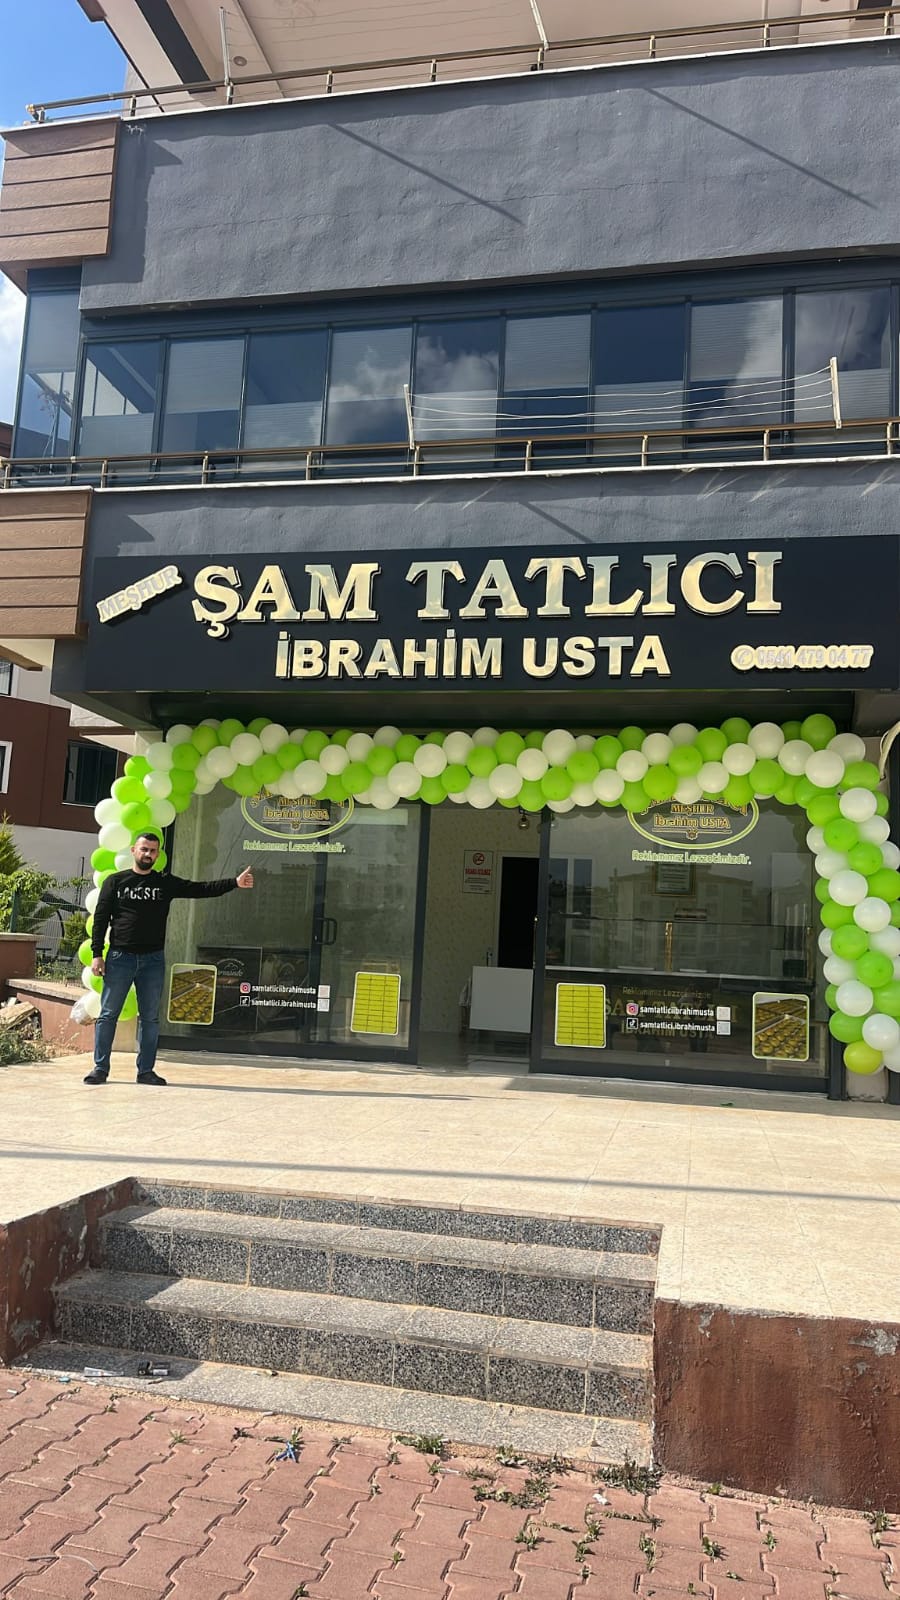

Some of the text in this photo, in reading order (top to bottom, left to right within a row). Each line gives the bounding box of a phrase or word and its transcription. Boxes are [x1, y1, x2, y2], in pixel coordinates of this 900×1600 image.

[97, 565, 183, 624] MEŞHUR
[191, 551, 783, 639] ŞAM TATLICI
[275, 628, 672, 679] İBRAHİM USTA
[850, 647, 873, 667] 77
[700, 817, 731, 829] USTA
